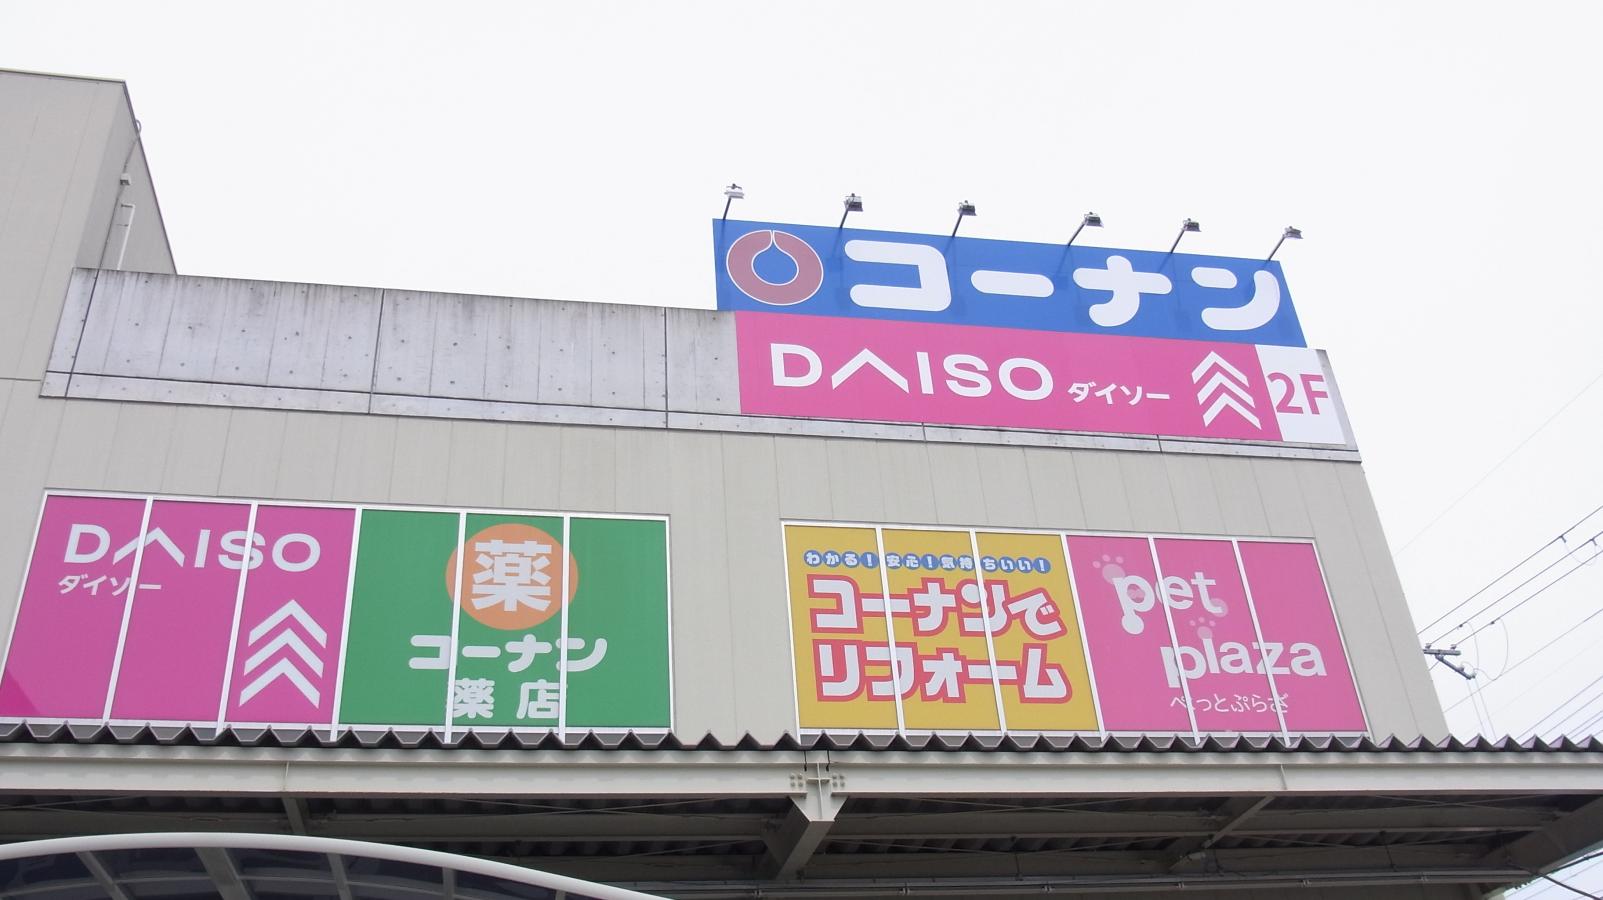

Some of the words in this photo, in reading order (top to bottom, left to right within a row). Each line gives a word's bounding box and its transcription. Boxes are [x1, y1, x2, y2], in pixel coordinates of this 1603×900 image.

[844, 239, 1280, 330] コーナン
[770, 342, 1054, 401] DAISO
[1067, 381, 1170, 406] ダイソー
[1267, 372, 1328, 415] 2F
[63, 523, 321, 572] DAISO
[58, 574, 162, 596] ダイソー
[470, 538, 553, 612] 薬
[809, 575, 1066, 639] コーナンで
[1112, 572, 1225, 635] pet
[409, 633, 608, 673] コーナン
[815, 641, 1071, 702] リフォーム
[1160, 638, 1328, 688] plaza
